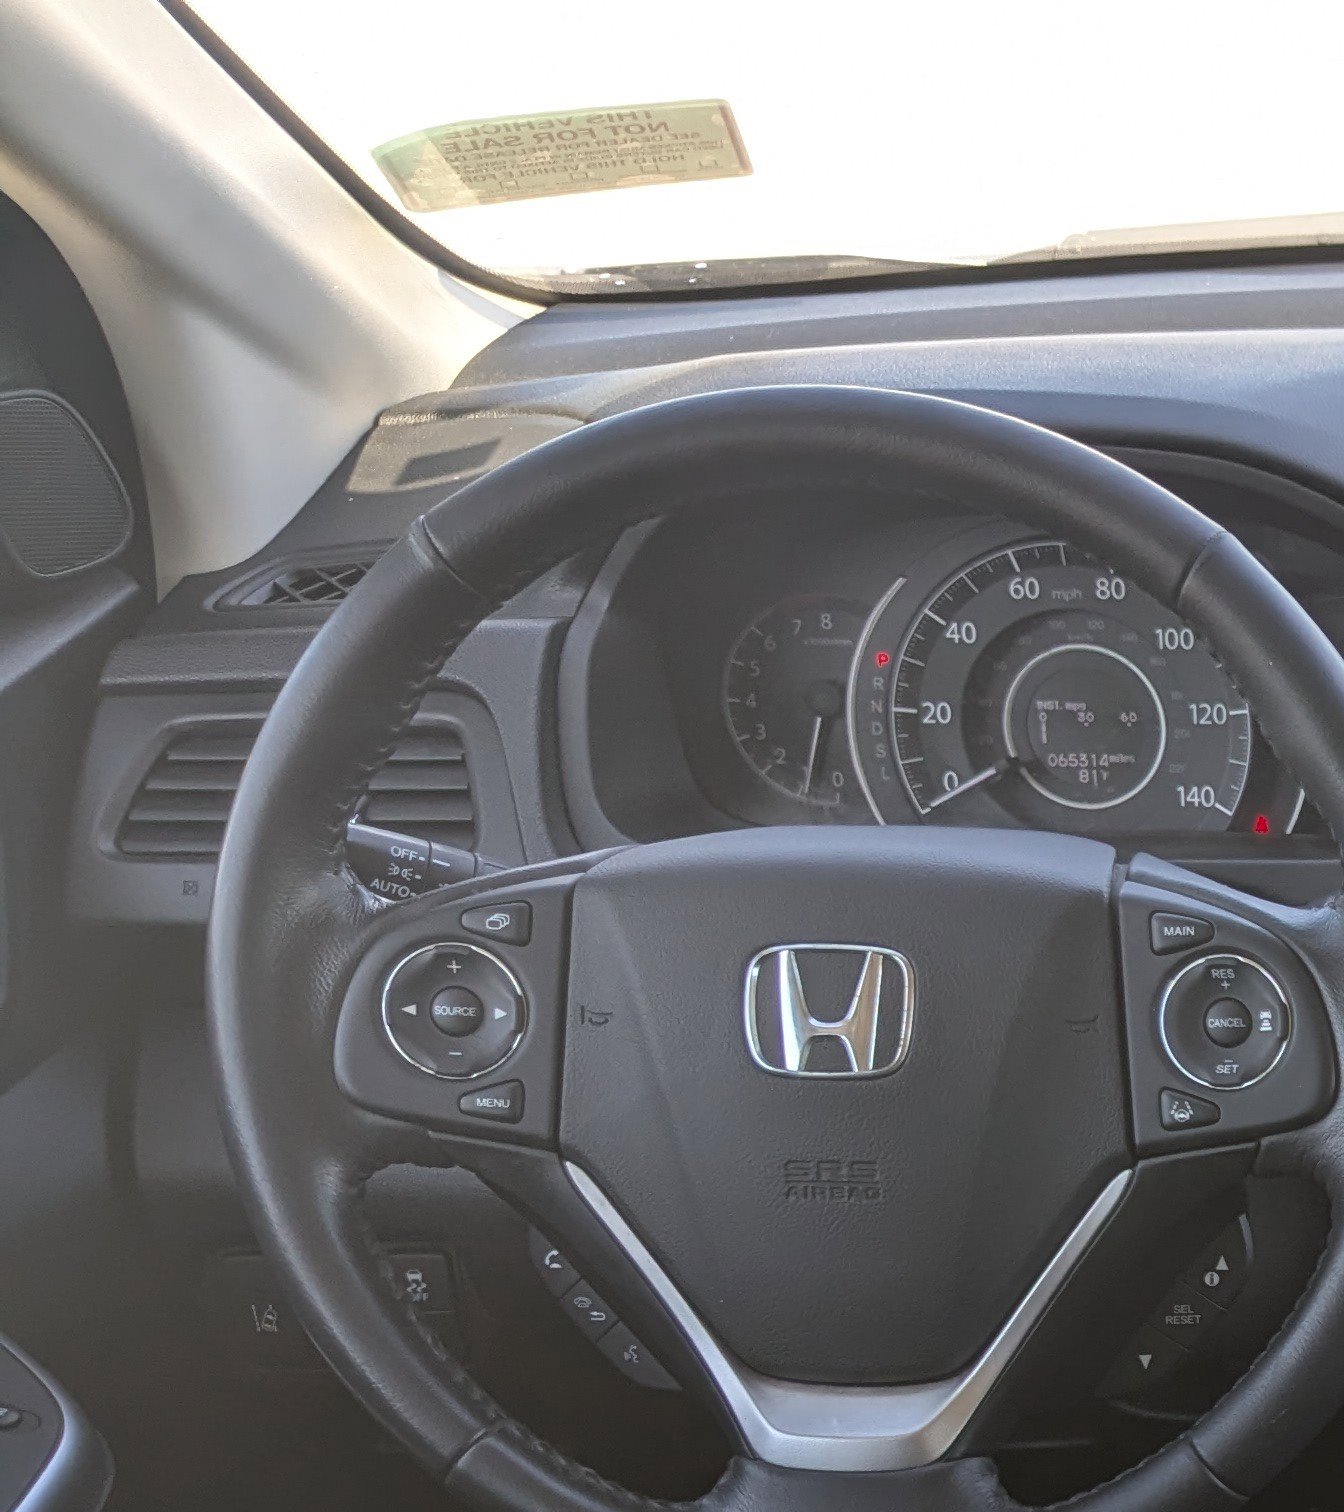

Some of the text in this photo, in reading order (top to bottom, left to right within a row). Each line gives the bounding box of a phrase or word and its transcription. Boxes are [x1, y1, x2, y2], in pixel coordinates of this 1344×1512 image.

[1009, 577, 1040, 600] 60
[1095, 577, 1126, 600] 80
[821, 613, 833, 630] 8
[945, 621, 977, 644] 40
[1154, 627, 1195, 651] 100
[876, 652, 891, 668] P
[874, 677, 884, 690] R
[921, 701, 952, 725] 20
[1120, 711, 1138, 723] 60
[1189, 703, 1228, 726] 120
[755, 723, 767, 741] 3
[1048, 753, 1110, 768] 065314
[832, 771, 845, 788] 0
[943, 770, 959, 792] 0
[1176, 785, 1215, 808] 140
[390, 845, 418, 861] OFF
[369, 878, 411, 898] AUTO
[1163, 925, 1195, 937] MAIN
[1211, 968, 1235, 979] RES
[433, 1005, 477, 1017] SOURCE
[1208, 1017, 1247, 1029] CANCEL
[1215, 1064, 1240, 1075] SET
[476, 1098, 511, 1109] MENU
[1173, 1304, 1195, 1314] SEL
[1165, 1314, 1202, 1325] RESET
